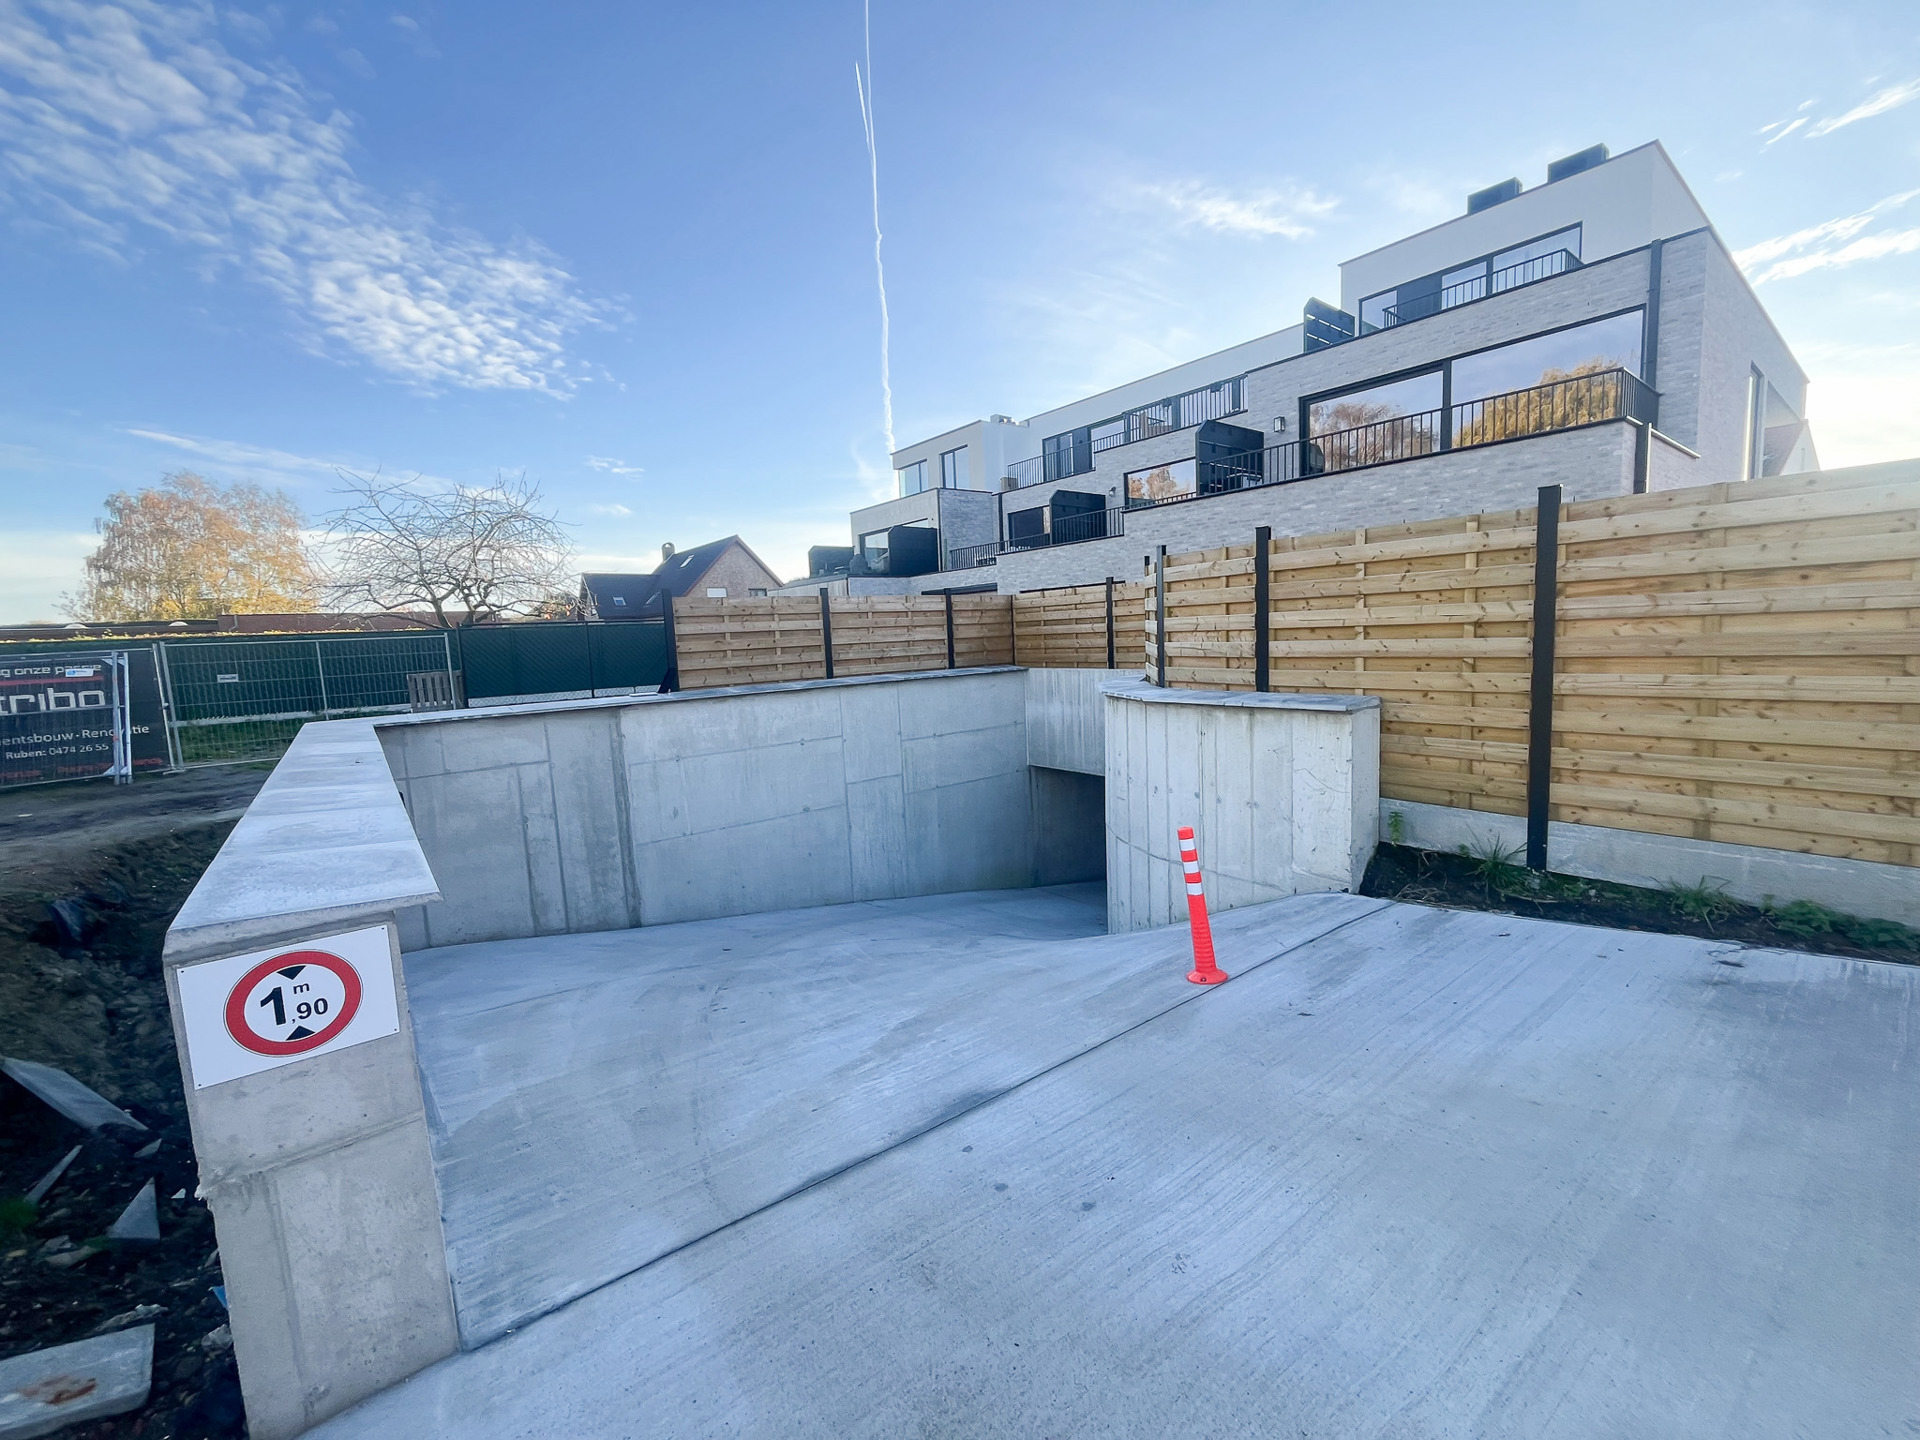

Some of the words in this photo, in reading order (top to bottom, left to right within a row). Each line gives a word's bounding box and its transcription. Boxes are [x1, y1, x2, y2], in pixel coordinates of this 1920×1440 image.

[14, 666, 51, 676] onze
[0, 733, 74, 746] entsbouw
[82, 725, 150, 739] Renotie
[5, 750, 47, 760] Ruben:
[48, 746, 76, 756] 0474
[79, 744, 93, 753] 26
[260, 986, 286, 1026] 1
